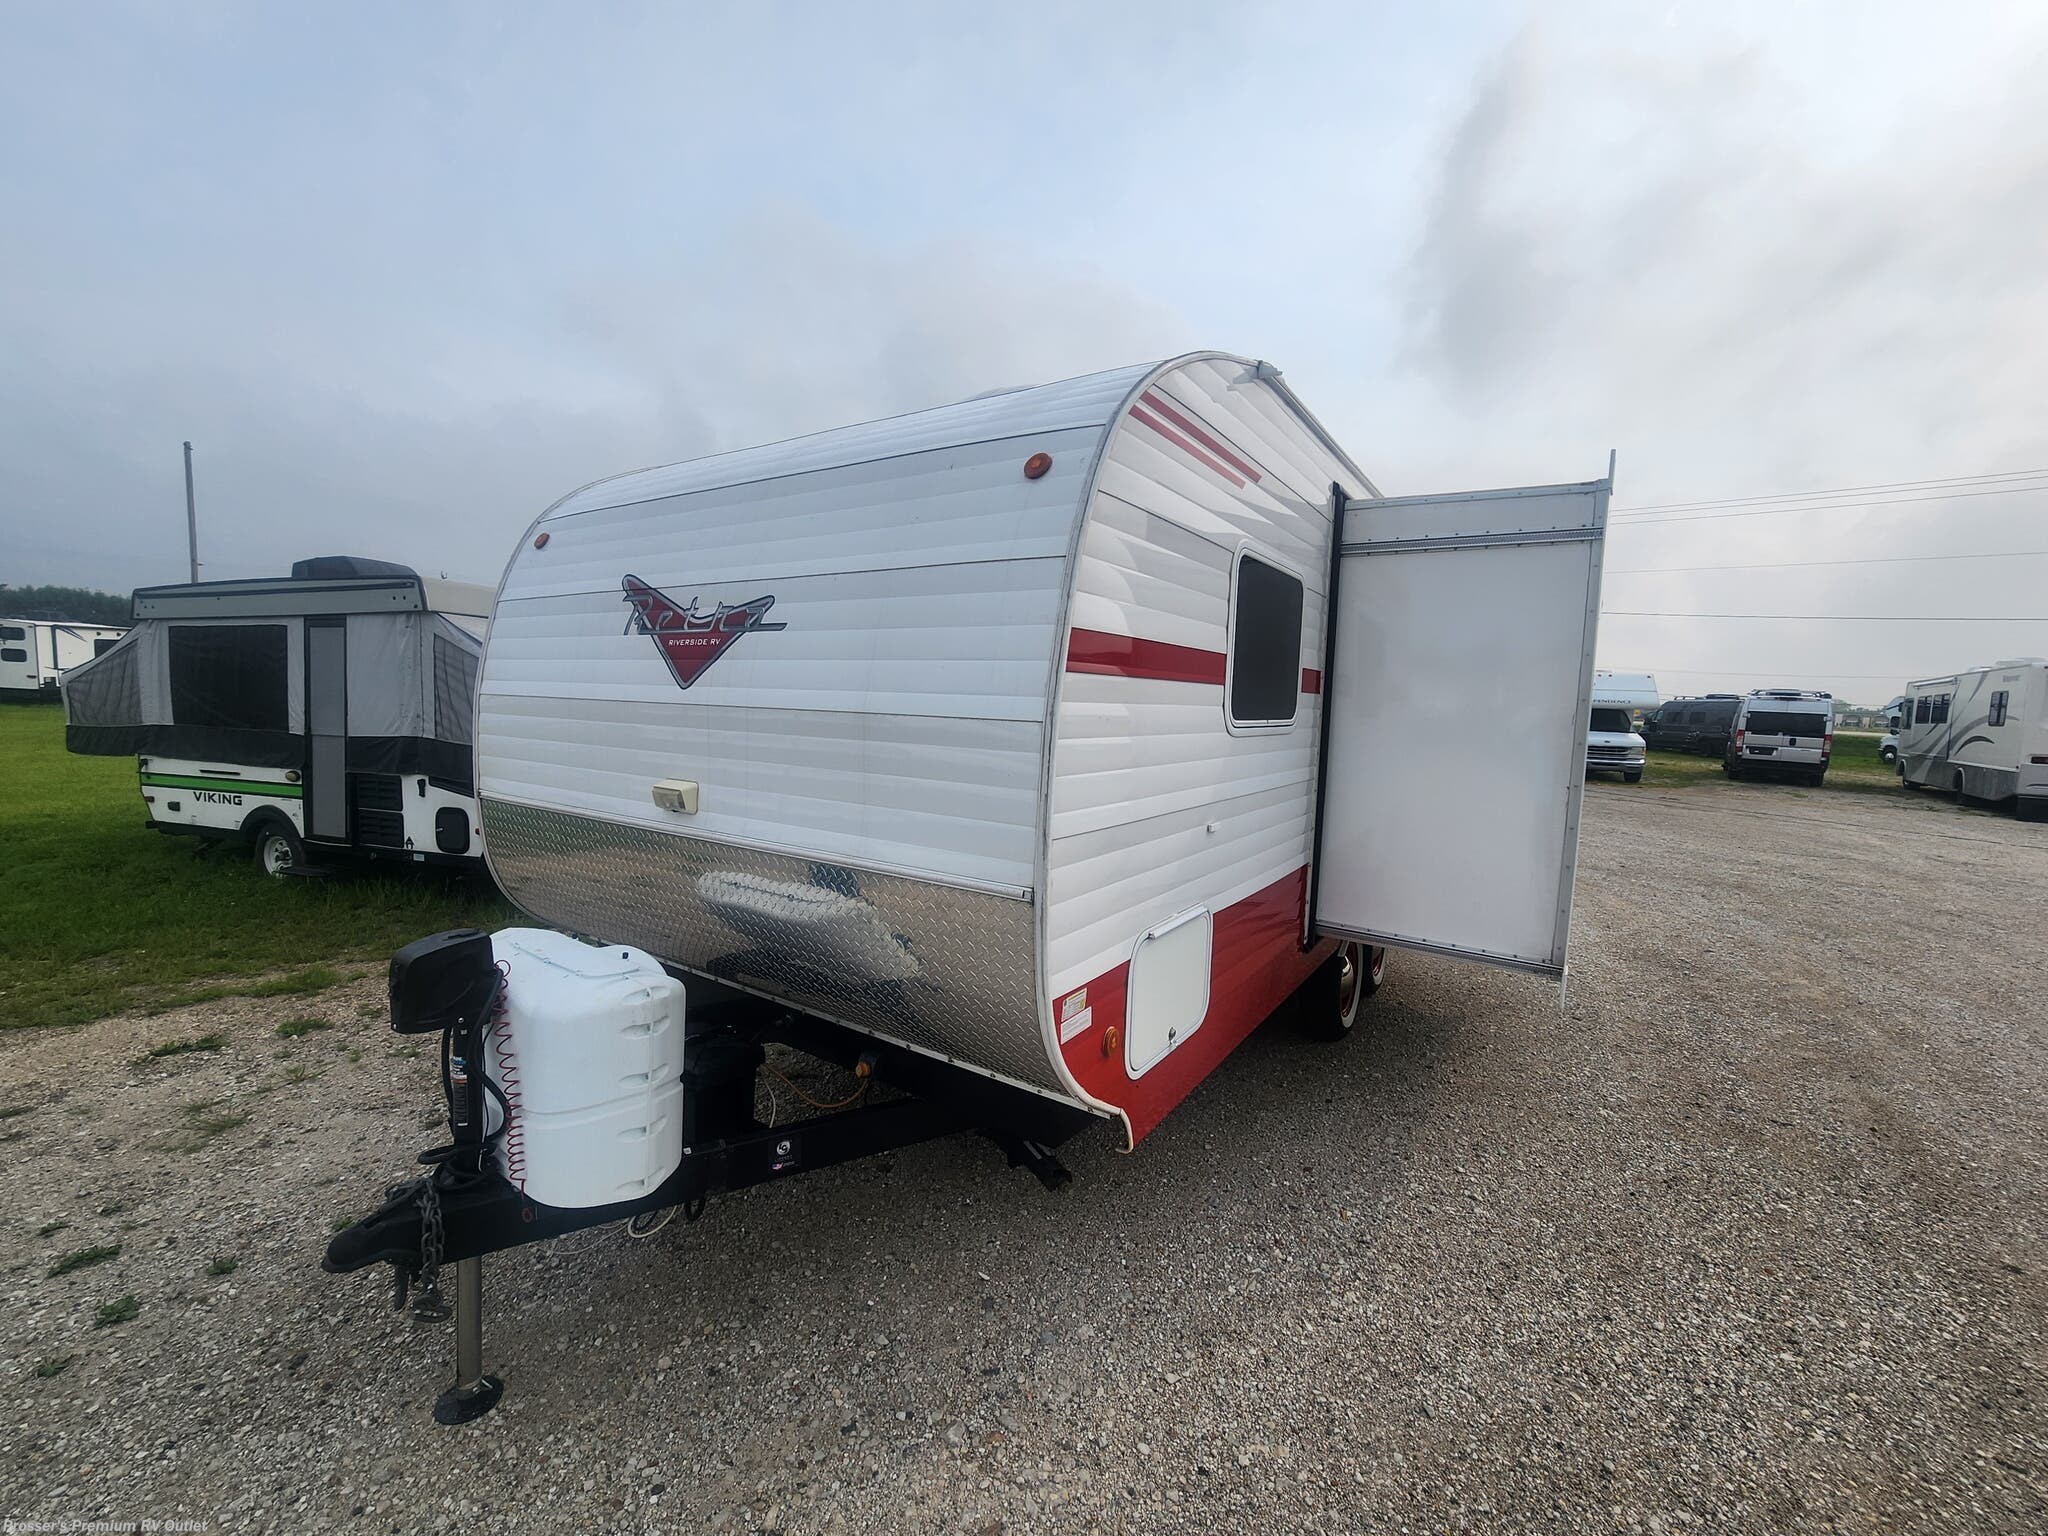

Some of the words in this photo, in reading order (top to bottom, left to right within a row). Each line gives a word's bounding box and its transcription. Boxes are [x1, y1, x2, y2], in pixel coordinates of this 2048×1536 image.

[668, 638, 708, 646] RIVERSIDE
[710, 638, 721, 646] RV
[193, 791, 243, 806] VIKING
